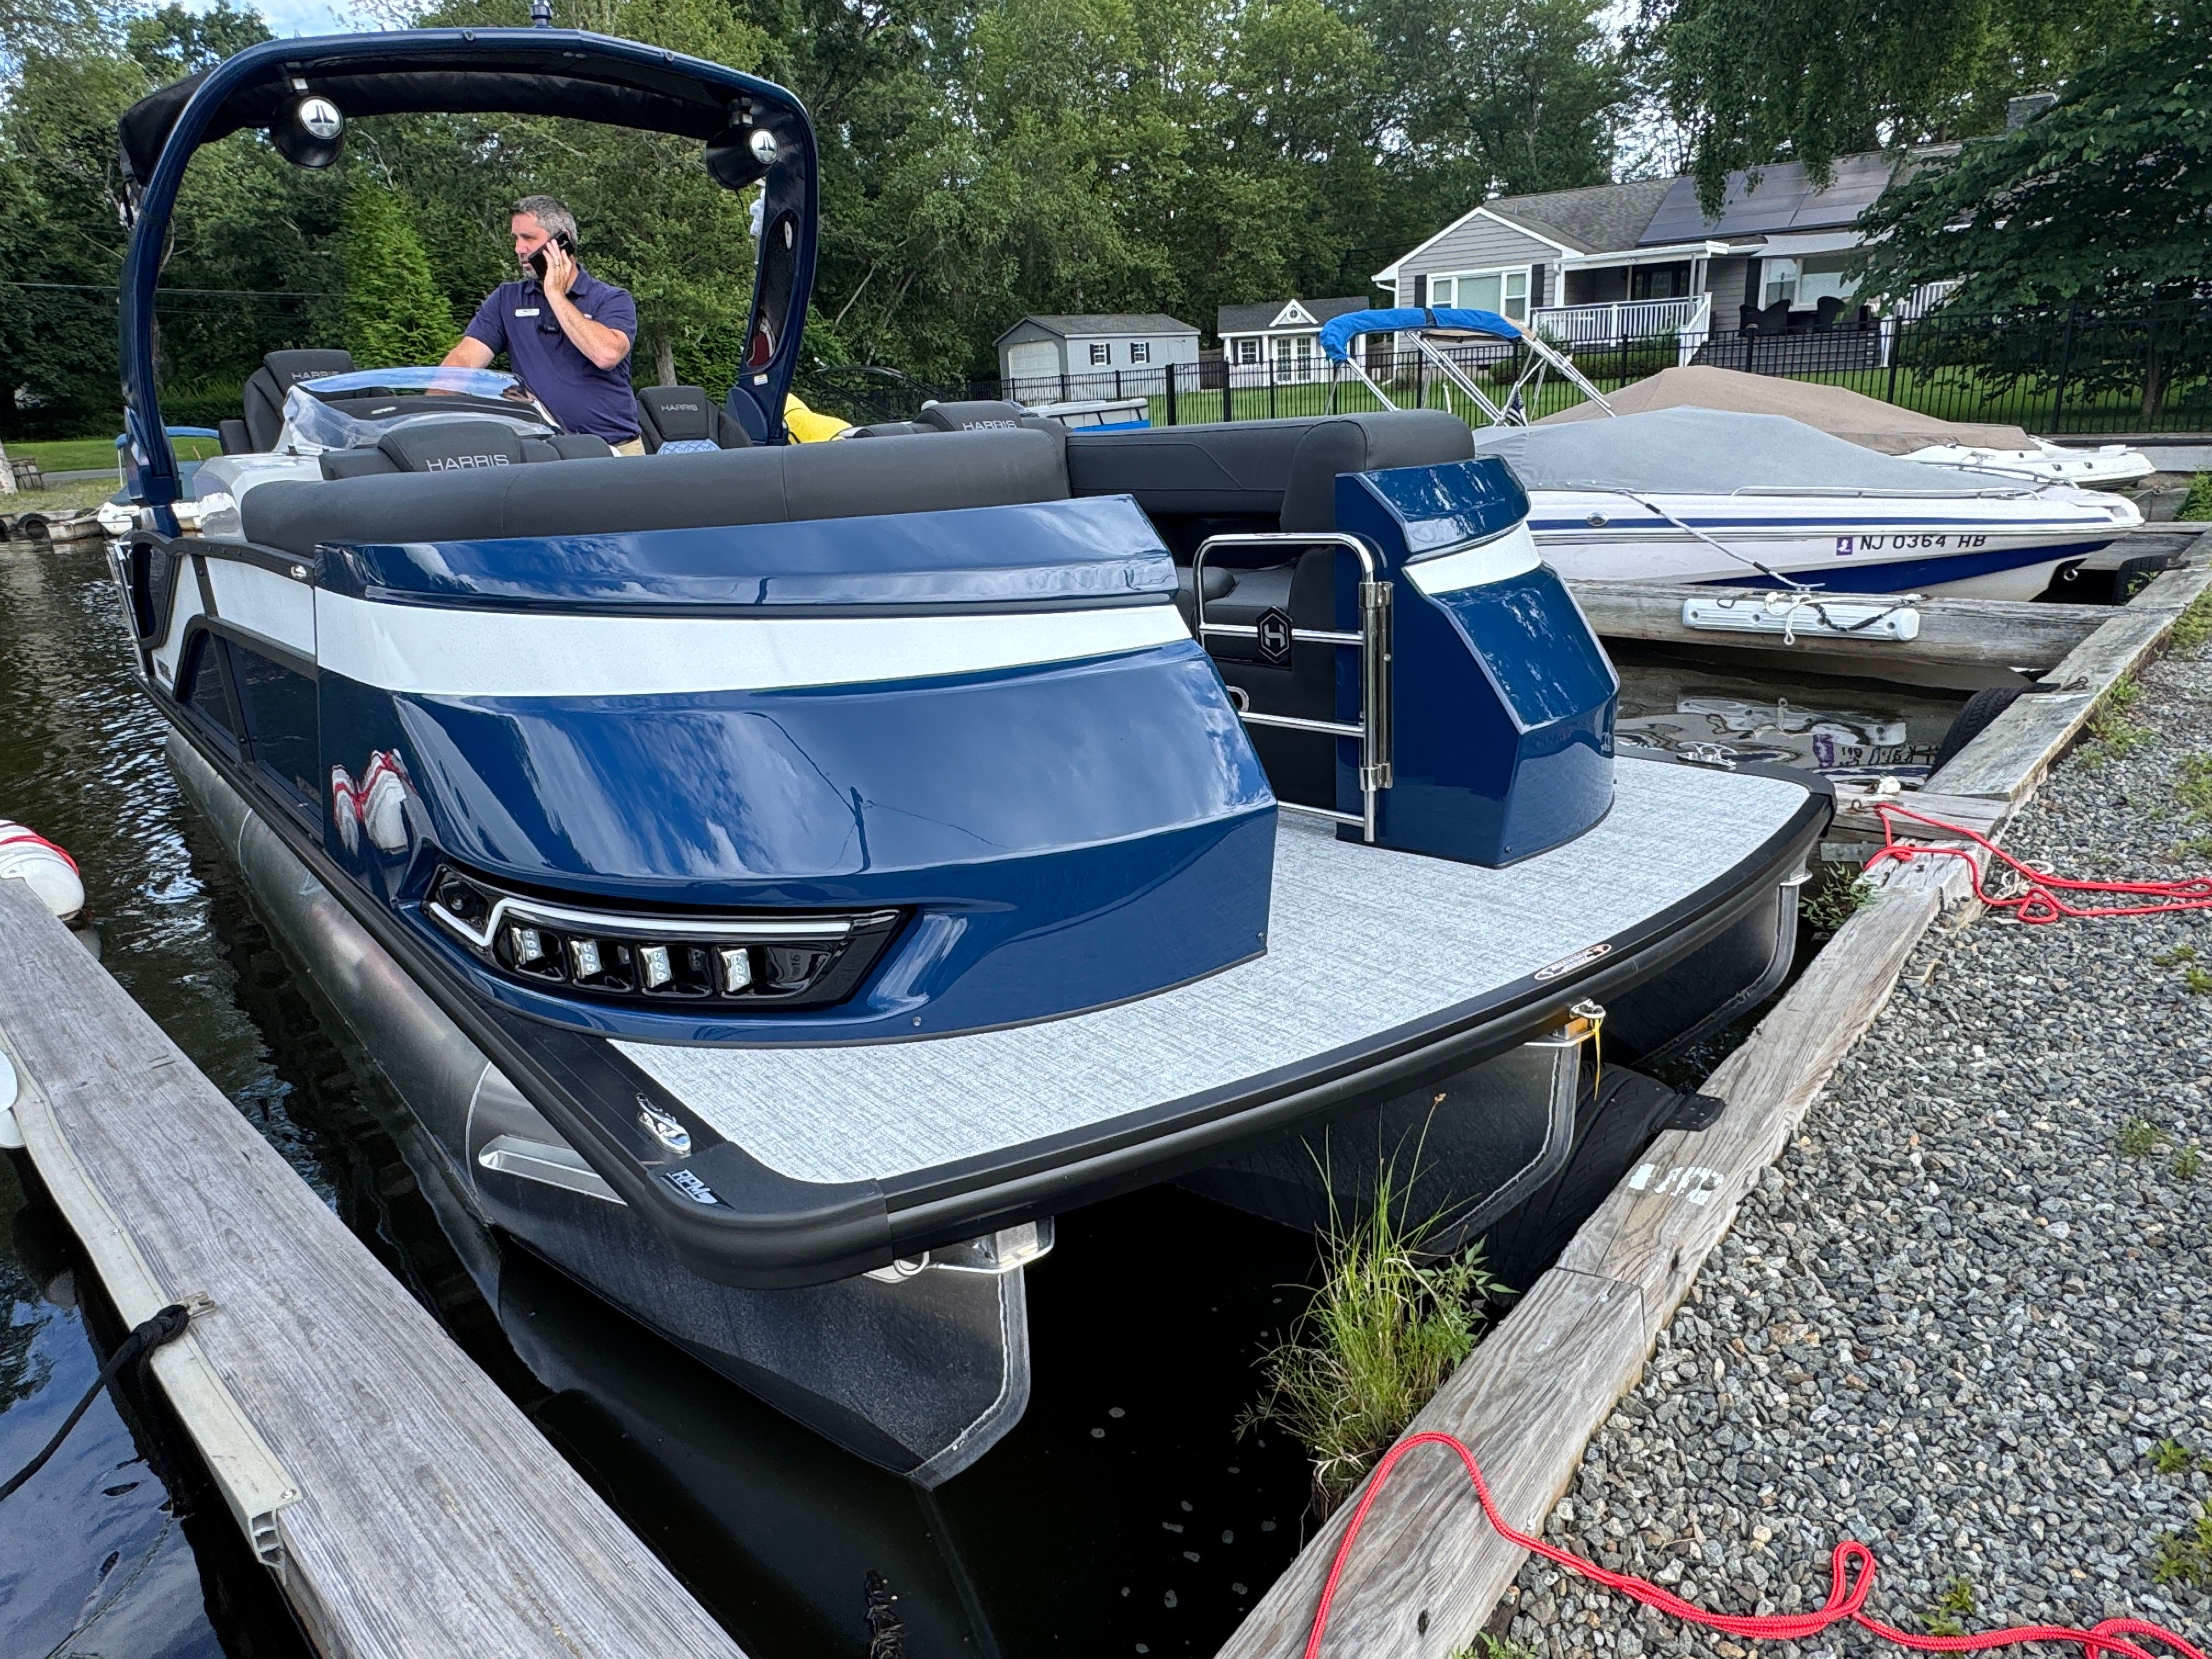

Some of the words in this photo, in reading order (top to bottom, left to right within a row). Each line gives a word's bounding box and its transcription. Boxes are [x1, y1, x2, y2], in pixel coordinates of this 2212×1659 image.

[426, 454, 509, 472] HARRIS
[1860, 535, 1885, 550] NJ
[1893, 535, 1945, 549] 0364
[1957, 535, 1987, 548] HB
